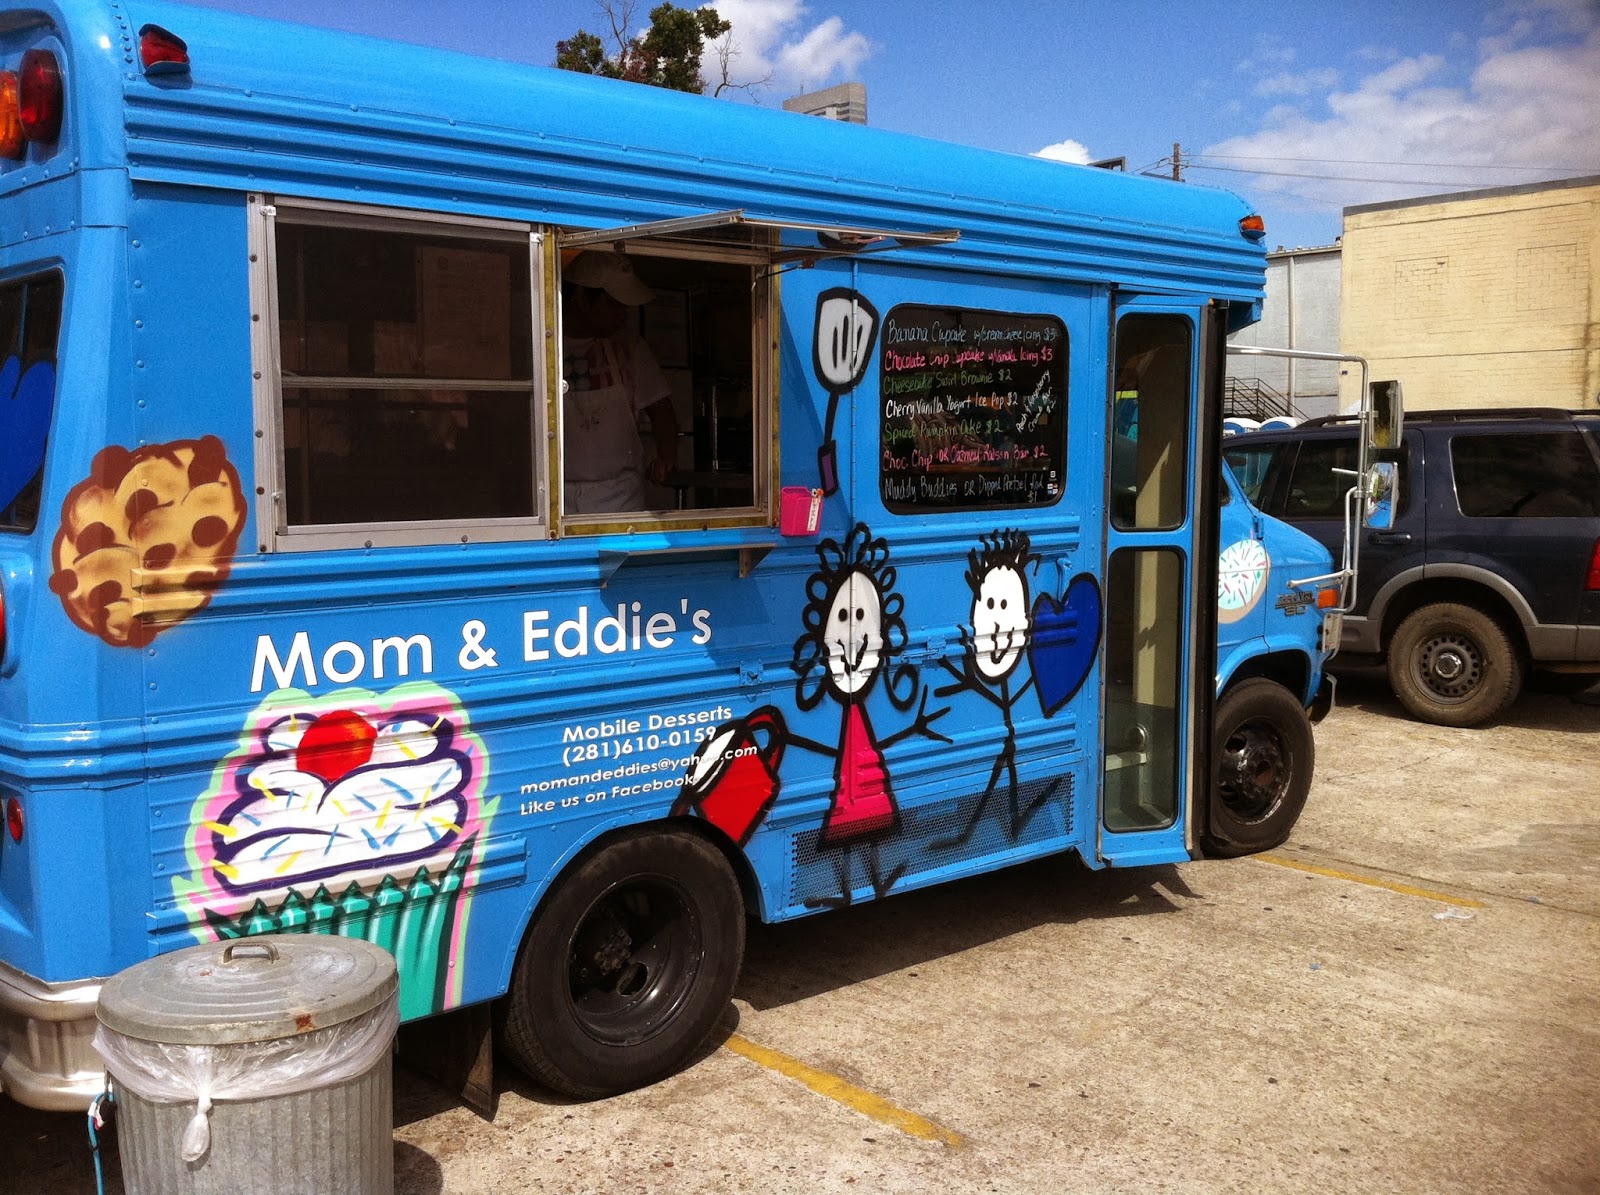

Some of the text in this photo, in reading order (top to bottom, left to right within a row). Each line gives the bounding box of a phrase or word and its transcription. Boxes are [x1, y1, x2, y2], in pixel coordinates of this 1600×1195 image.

[888, 319, 928, 344] Banana
[932, 321, 966, 347] Cupcake
[1044, 327, 1056, 340] $3
[885, 350, 926, 371] Chocolate
[930, 351, 949, 368] Chip
[1041, 346, 1053, 361] $3
[884, 369, 1012, 394] Cheesecake Swirl Brownie $2
[886, 392, 1018, 420] Cherry Vanilla Yogurt Ice Pop $2
[885, 419, 1003, 444] Spiced Pumpkin Cake $2
[911, 449, 933, 471] Chip
[1014, 444, 1029, 459] Bar
[1034, 445, 1048, 458] $2
[885, 477, 916, 501] Muddy
[921, 476, 957, 497] Buddies
[964, 480, 975, 496] OR
[979, 474, 1001, 494] Dipped
[1003, 473, 1027, 491] Pretzel
[250, 598, 711, 692] Mom & Eddie's
[563, 705, 732, 743] Mobile Desserts
[563, 726, 716, 767] (281)610-0159
[520, 800, 555, 816] Like
[562, 796, 579, 808] us
[585, 791, 606, 803] on
